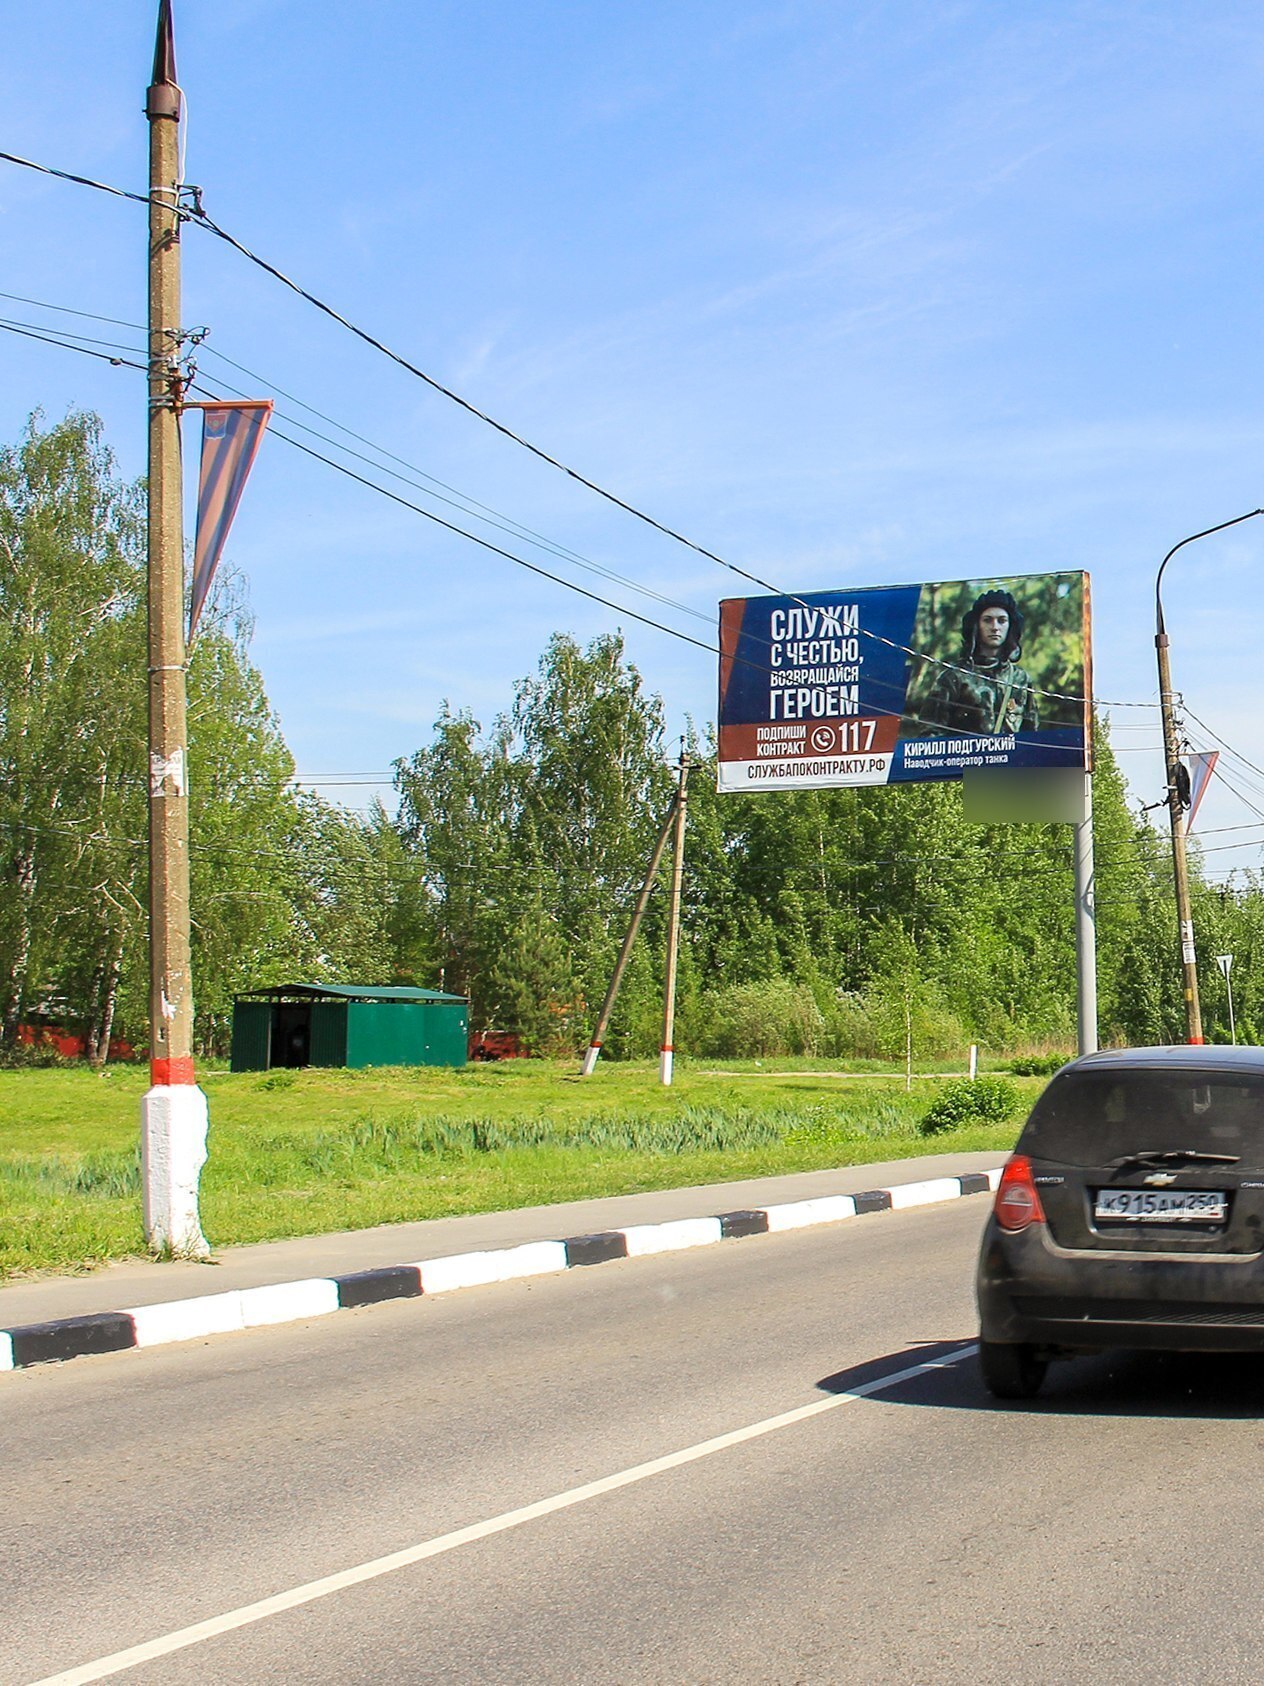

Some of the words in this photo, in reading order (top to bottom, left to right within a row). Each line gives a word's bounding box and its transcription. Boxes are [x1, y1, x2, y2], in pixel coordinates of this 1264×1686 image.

[771, 605, 859, 641] СЛУЖИ
[771, 643, 782, 667] С
[787, 638, 864, 665] ЧЕСТЬЮ,
[770, 664, 859, 687] ВОЗВРАЩАЙСЯ
[770, 685, 859, 719] ГЕРОЕМ
[757, 725, 806, 741] ПОДПИШИ
[839, 721, 876, 752] 117
[757, 741, 806, 756] КОНТРАКТ
[904, 741, 946, 756] КИРИЛЛ
[947, 734, 1015, 754] ПОДГУРСКИЙ
[748, 758, 886, 779] СЛУЖБАПОКОНТРАКТУ.РФ
[904, 757, 983, 769] Наводчик-оператор
[985, 754, 1008, 764] танка
